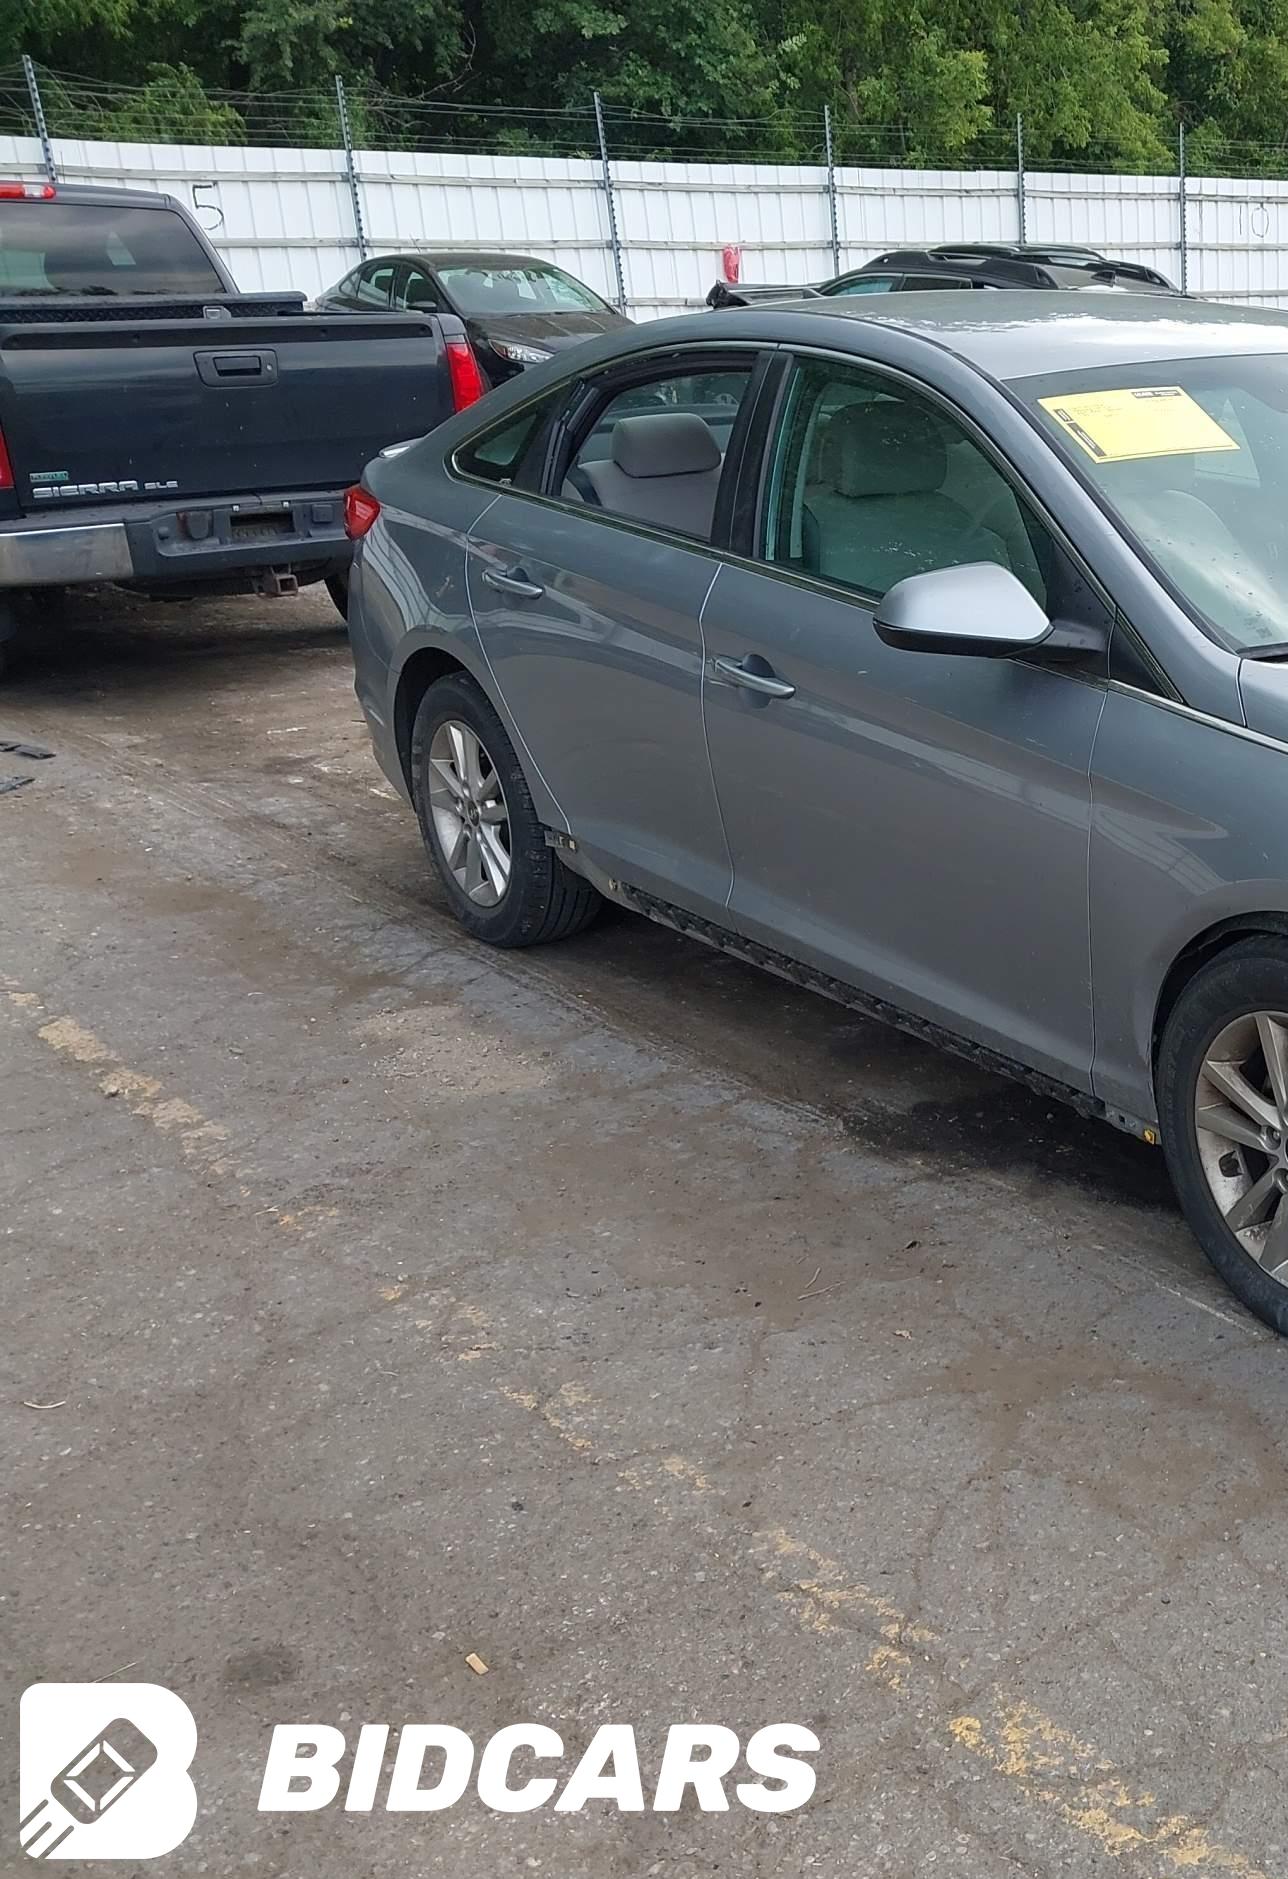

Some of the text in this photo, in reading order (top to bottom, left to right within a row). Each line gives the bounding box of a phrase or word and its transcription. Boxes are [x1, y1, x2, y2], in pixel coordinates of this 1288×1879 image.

[191, 184, 225, 231] 5
[32, 480, 179, 499] SIERRA SLE
